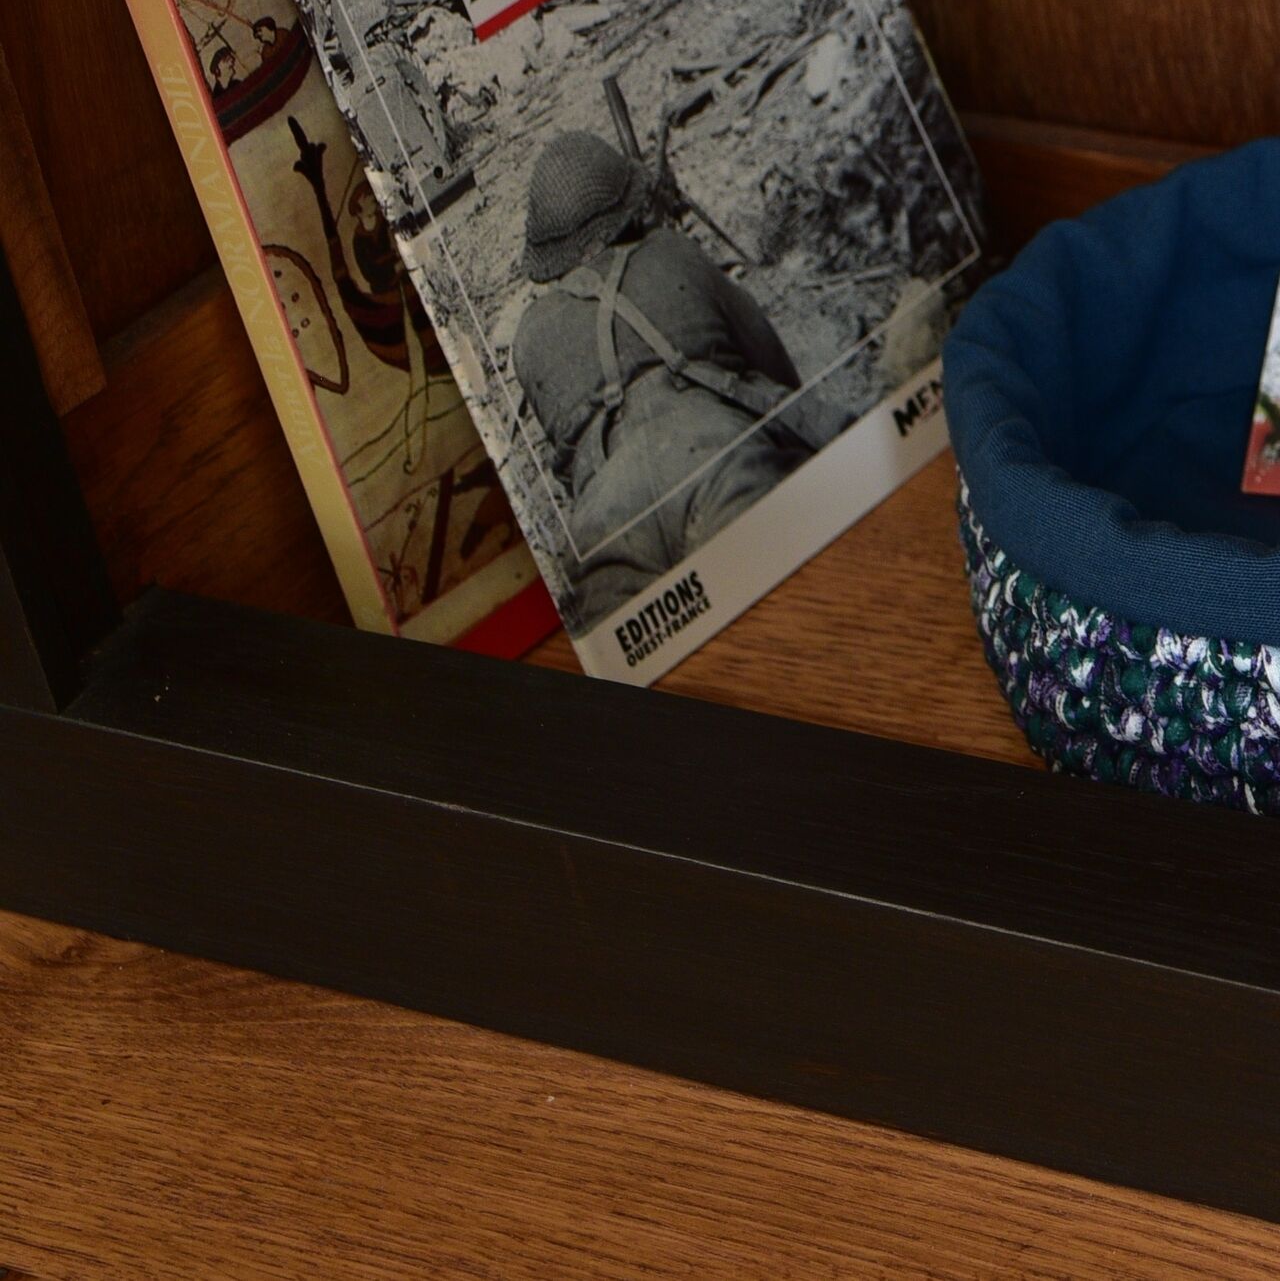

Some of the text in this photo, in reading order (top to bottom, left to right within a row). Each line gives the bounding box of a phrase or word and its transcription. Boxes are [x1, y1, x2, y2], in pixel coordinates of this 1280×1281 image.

[158, 62, 270, 325] NORMANDIE
[615, 570, 704, 652] EDITIONS
[627, 597, 711, 667] OUEST-FRANCE
